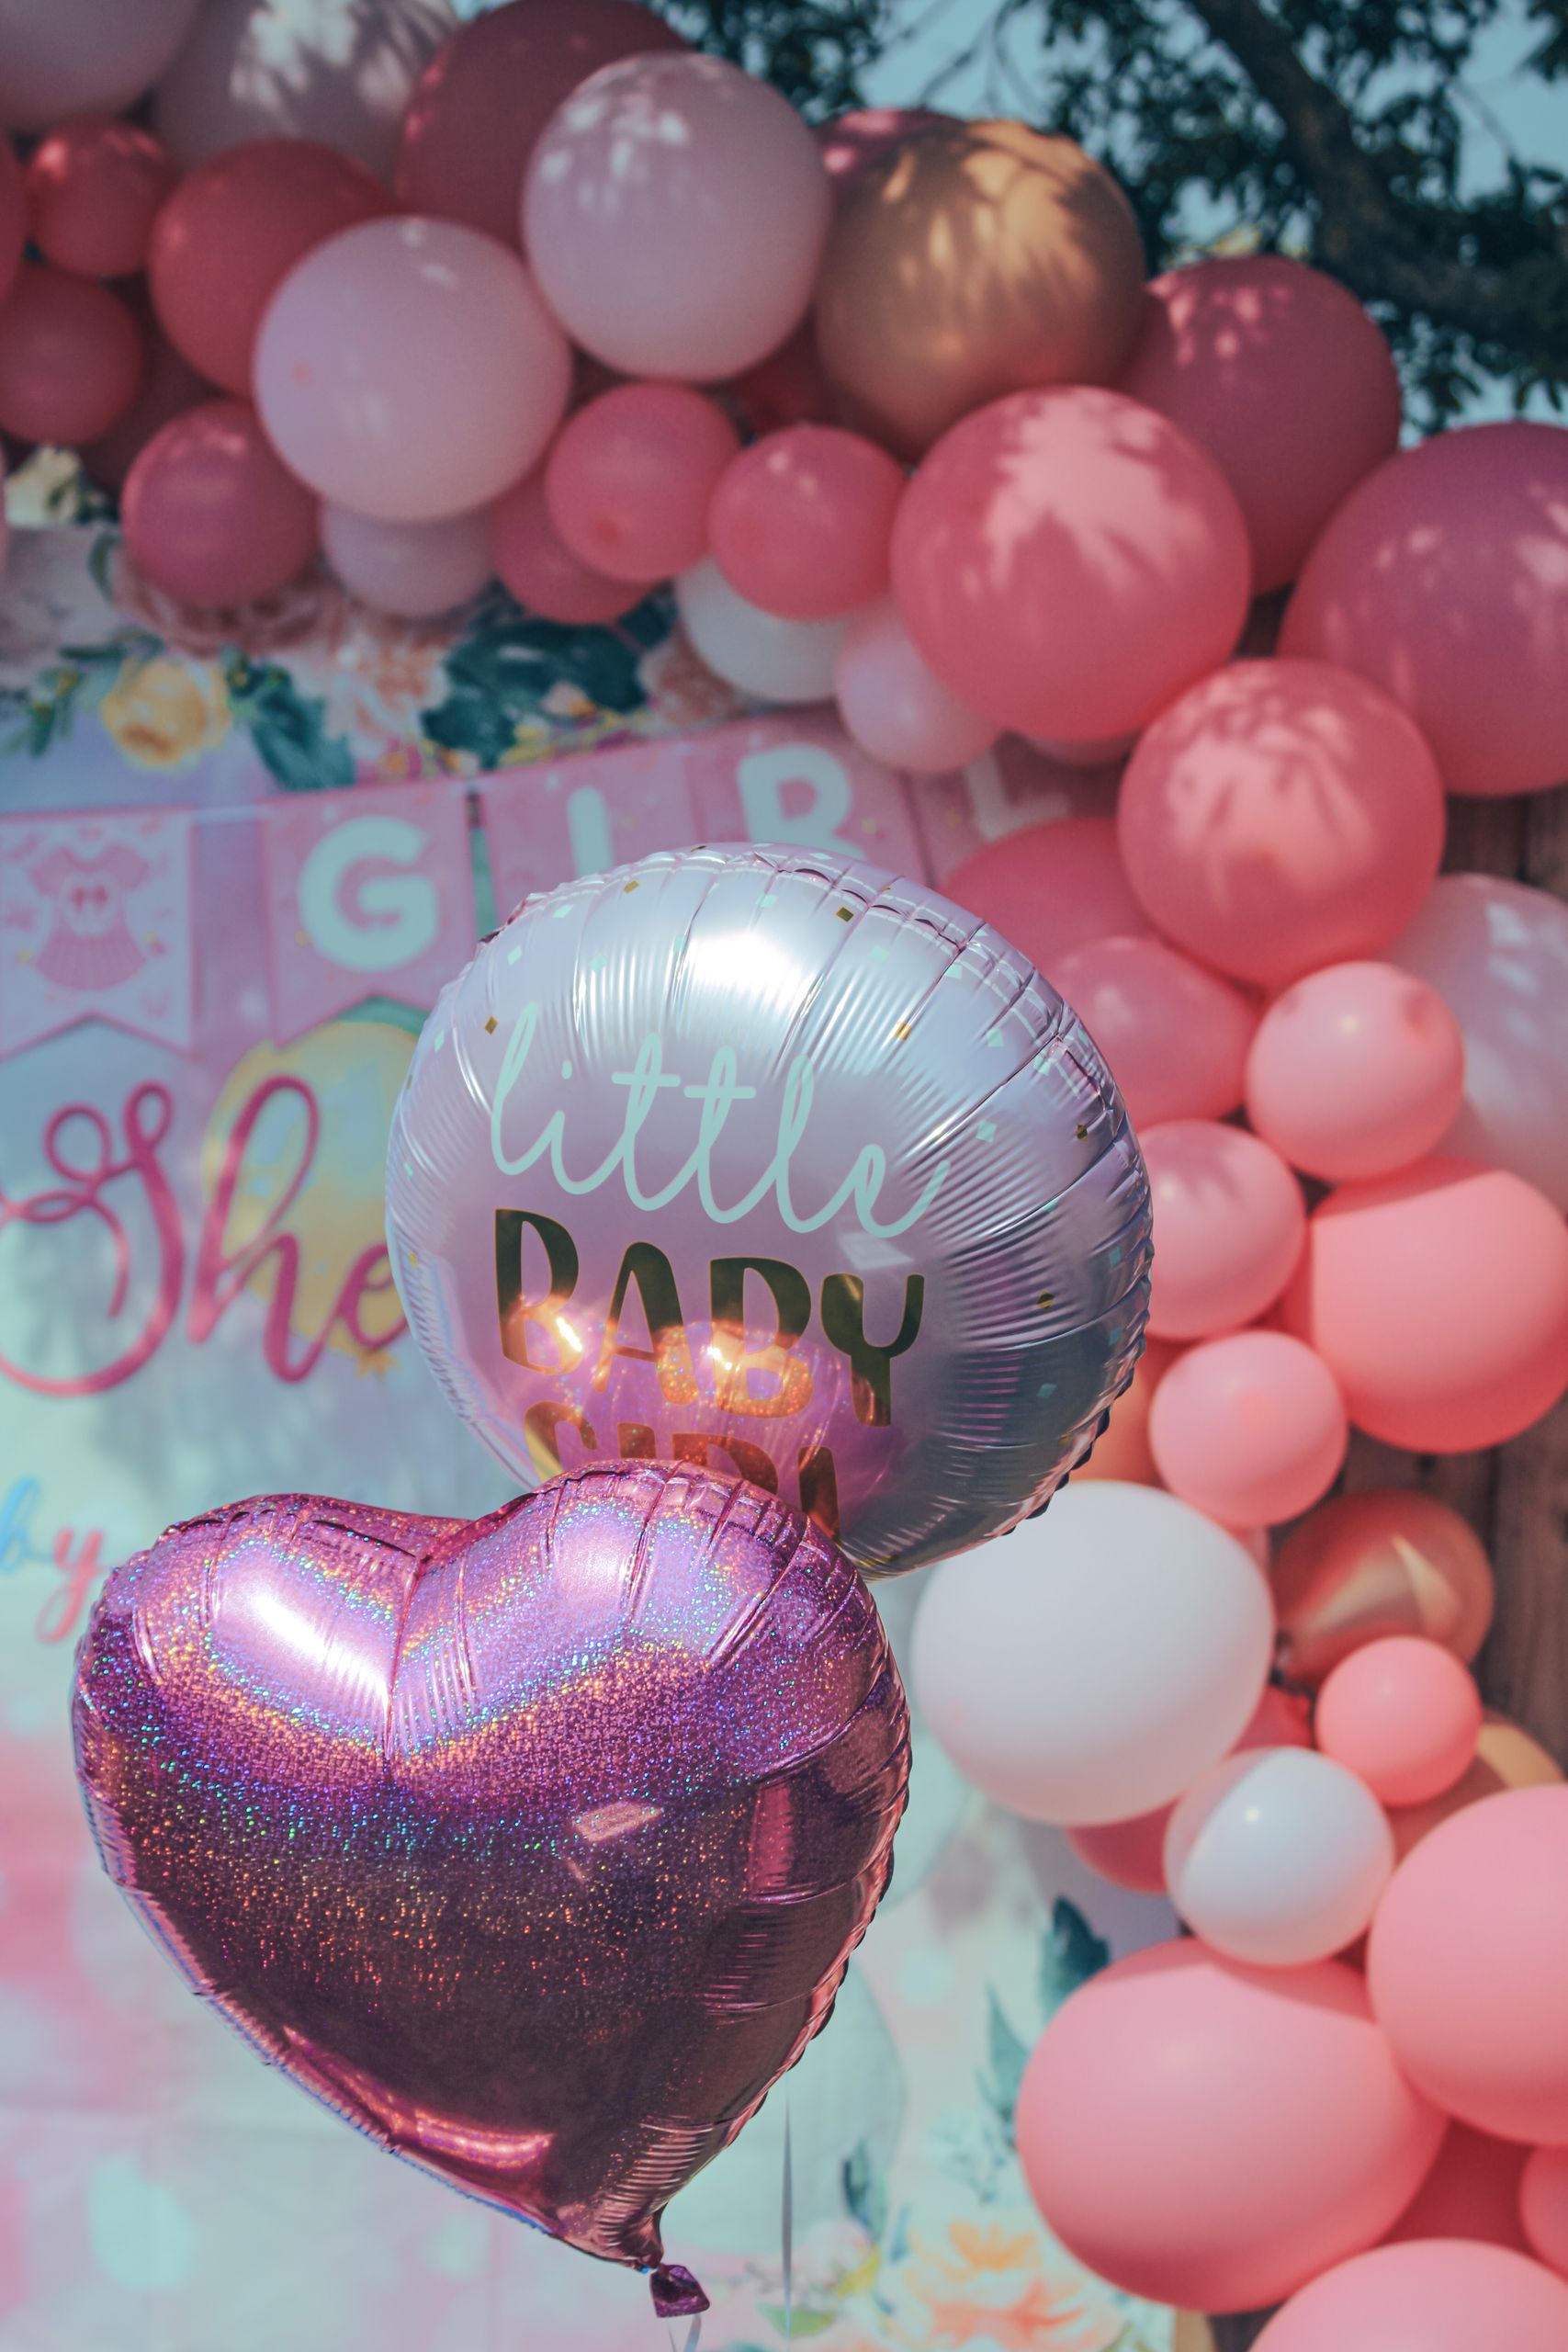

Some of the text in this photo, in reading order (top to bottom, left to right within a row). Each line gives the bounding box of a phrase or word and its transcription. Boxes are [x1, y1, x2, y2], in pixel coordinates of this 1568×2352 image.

[0, 1075, 410, 1397] She
[491, 1004, 951, 1238] little
[494, 1208, 926, 1427] BABY
